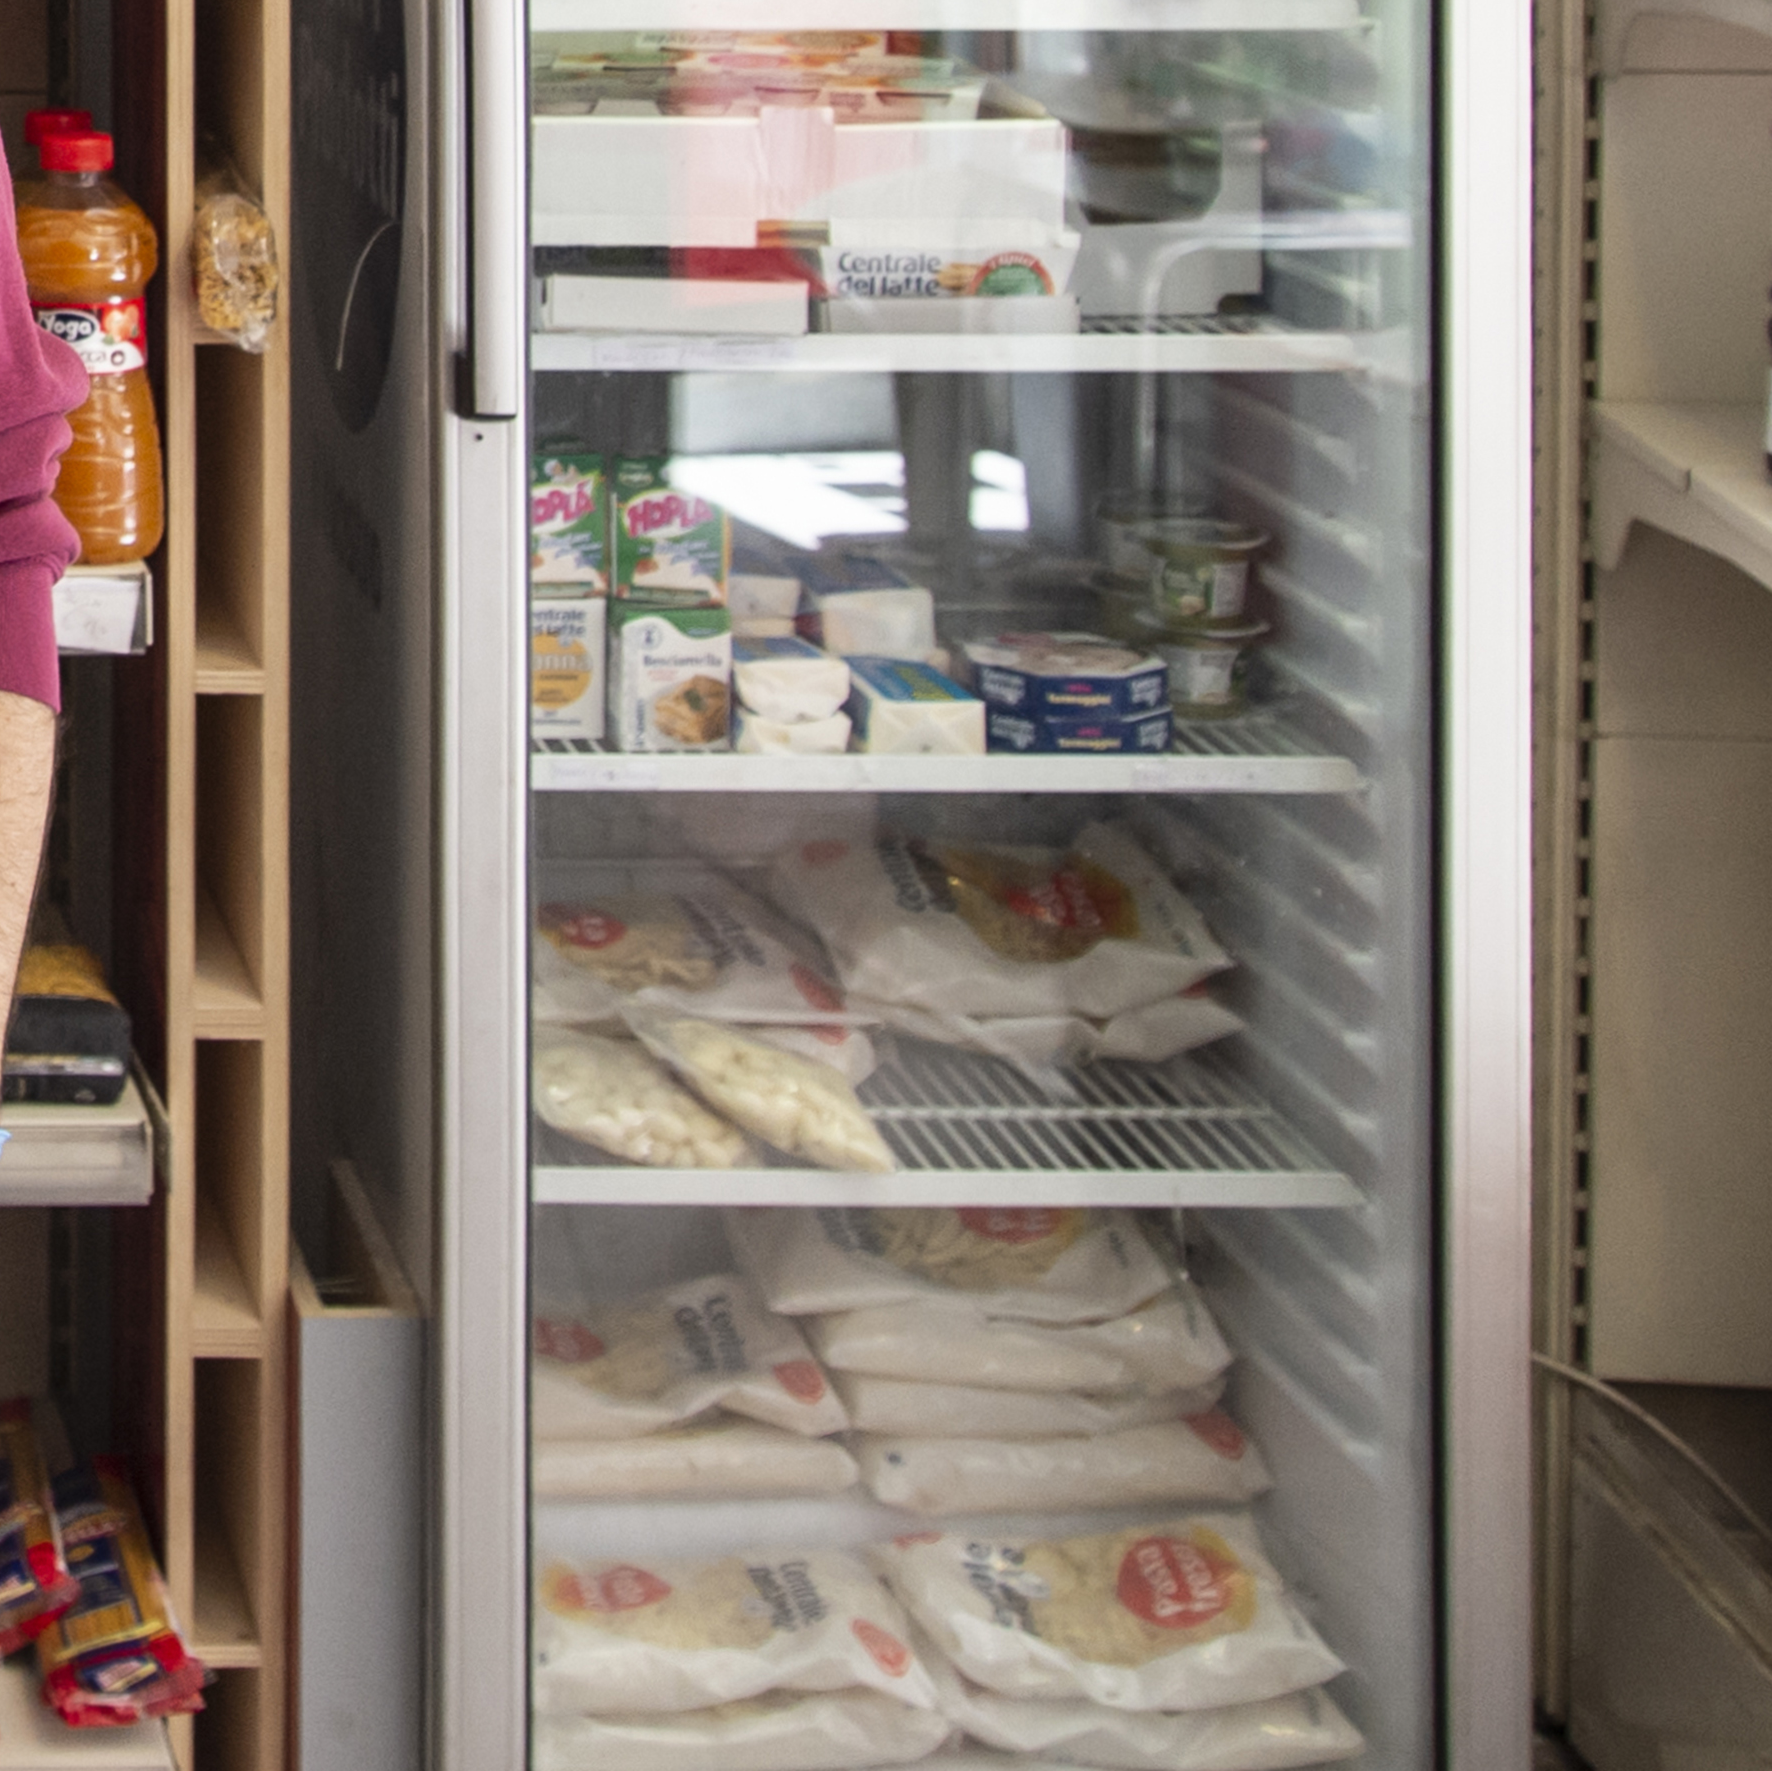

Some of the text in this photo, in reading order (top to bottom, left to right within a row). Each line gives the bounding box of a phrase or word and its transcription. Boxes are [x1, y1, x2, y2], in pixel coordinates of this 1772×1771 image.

[838, 251, 941, 273] Centrale
[880, 276, 941, 297] latte
[39, 312, 93, 342] Yoga
[532, 479, 595, 526] OPLÀ
[534, 610, 586, 622] entrale
[534, 653, 592, 670] anna
